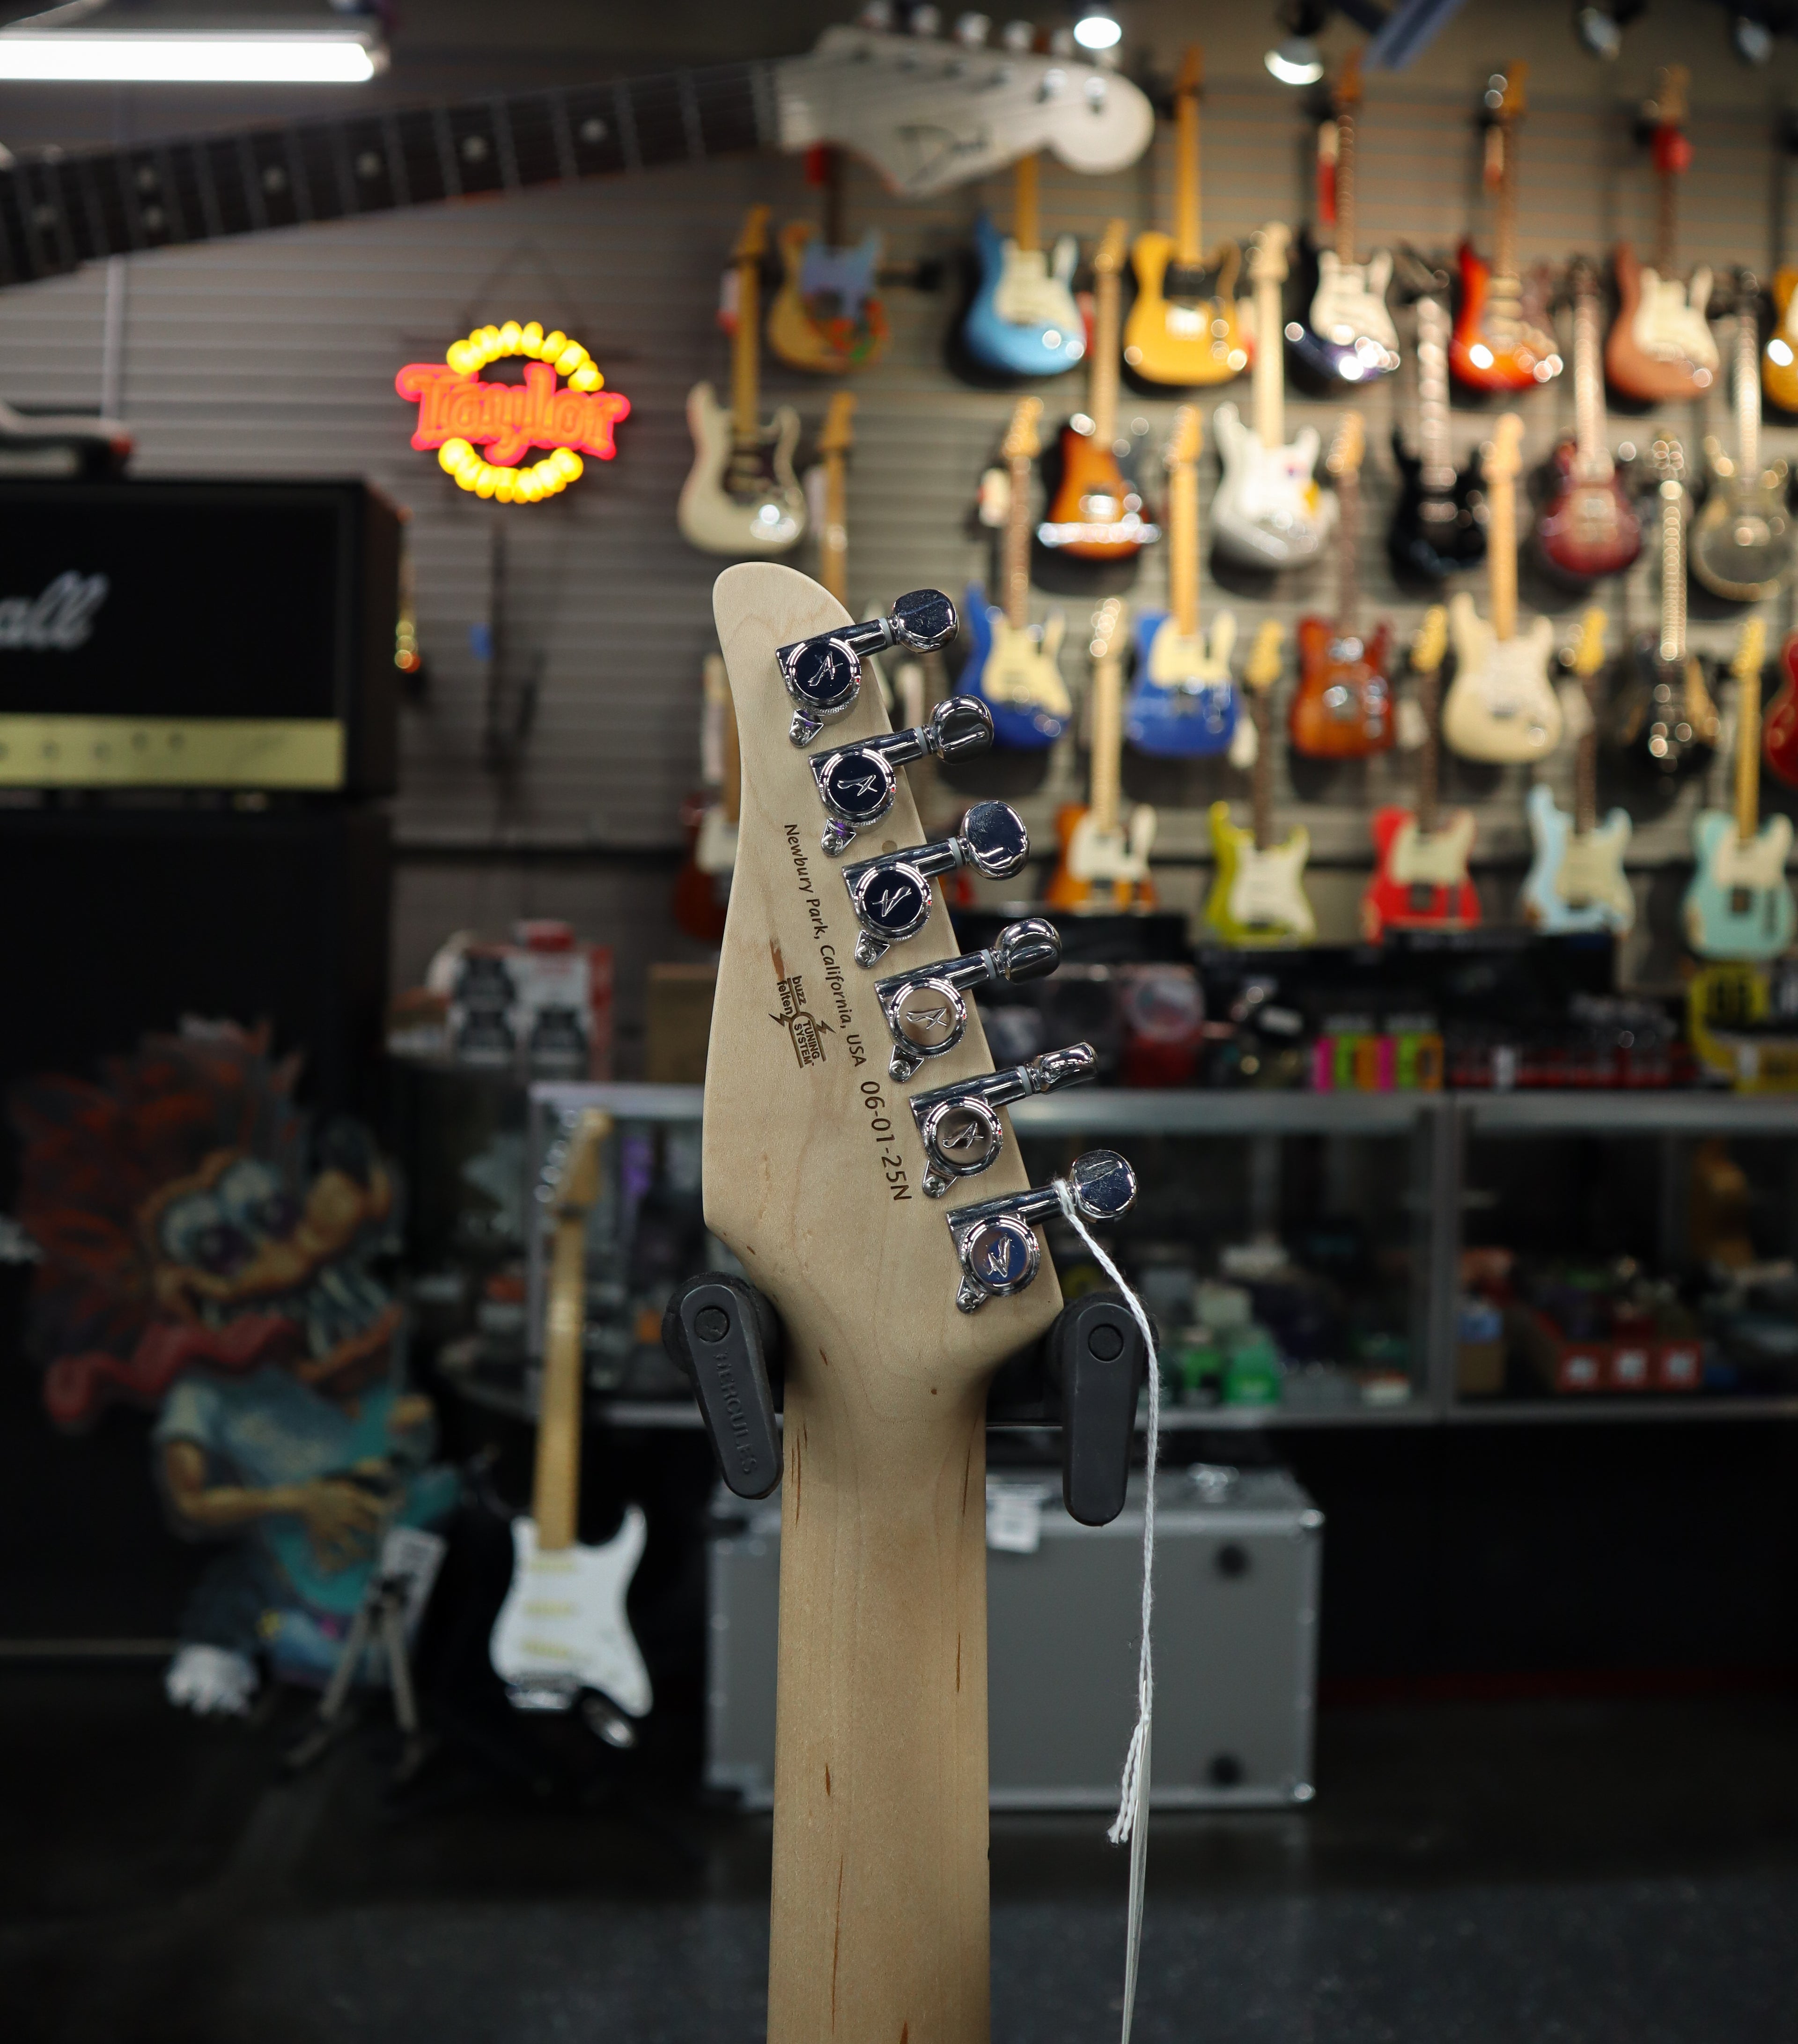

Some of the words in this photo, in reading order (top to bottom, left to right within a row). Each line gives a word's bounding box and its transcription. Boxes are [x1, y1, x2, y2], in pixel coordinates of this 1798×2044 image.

[784, 824, 814, 893] Newbury
[806, 899, 828, 939] Park,
[820, 945, 852, 1029] California,
[846, 1034, 867, 1067] USA
[792, 975, 807, 1006] buzz
[803, 1020, 820, 1059] TUNING
[860, 1081, 912, 1201] 06-01-25N
